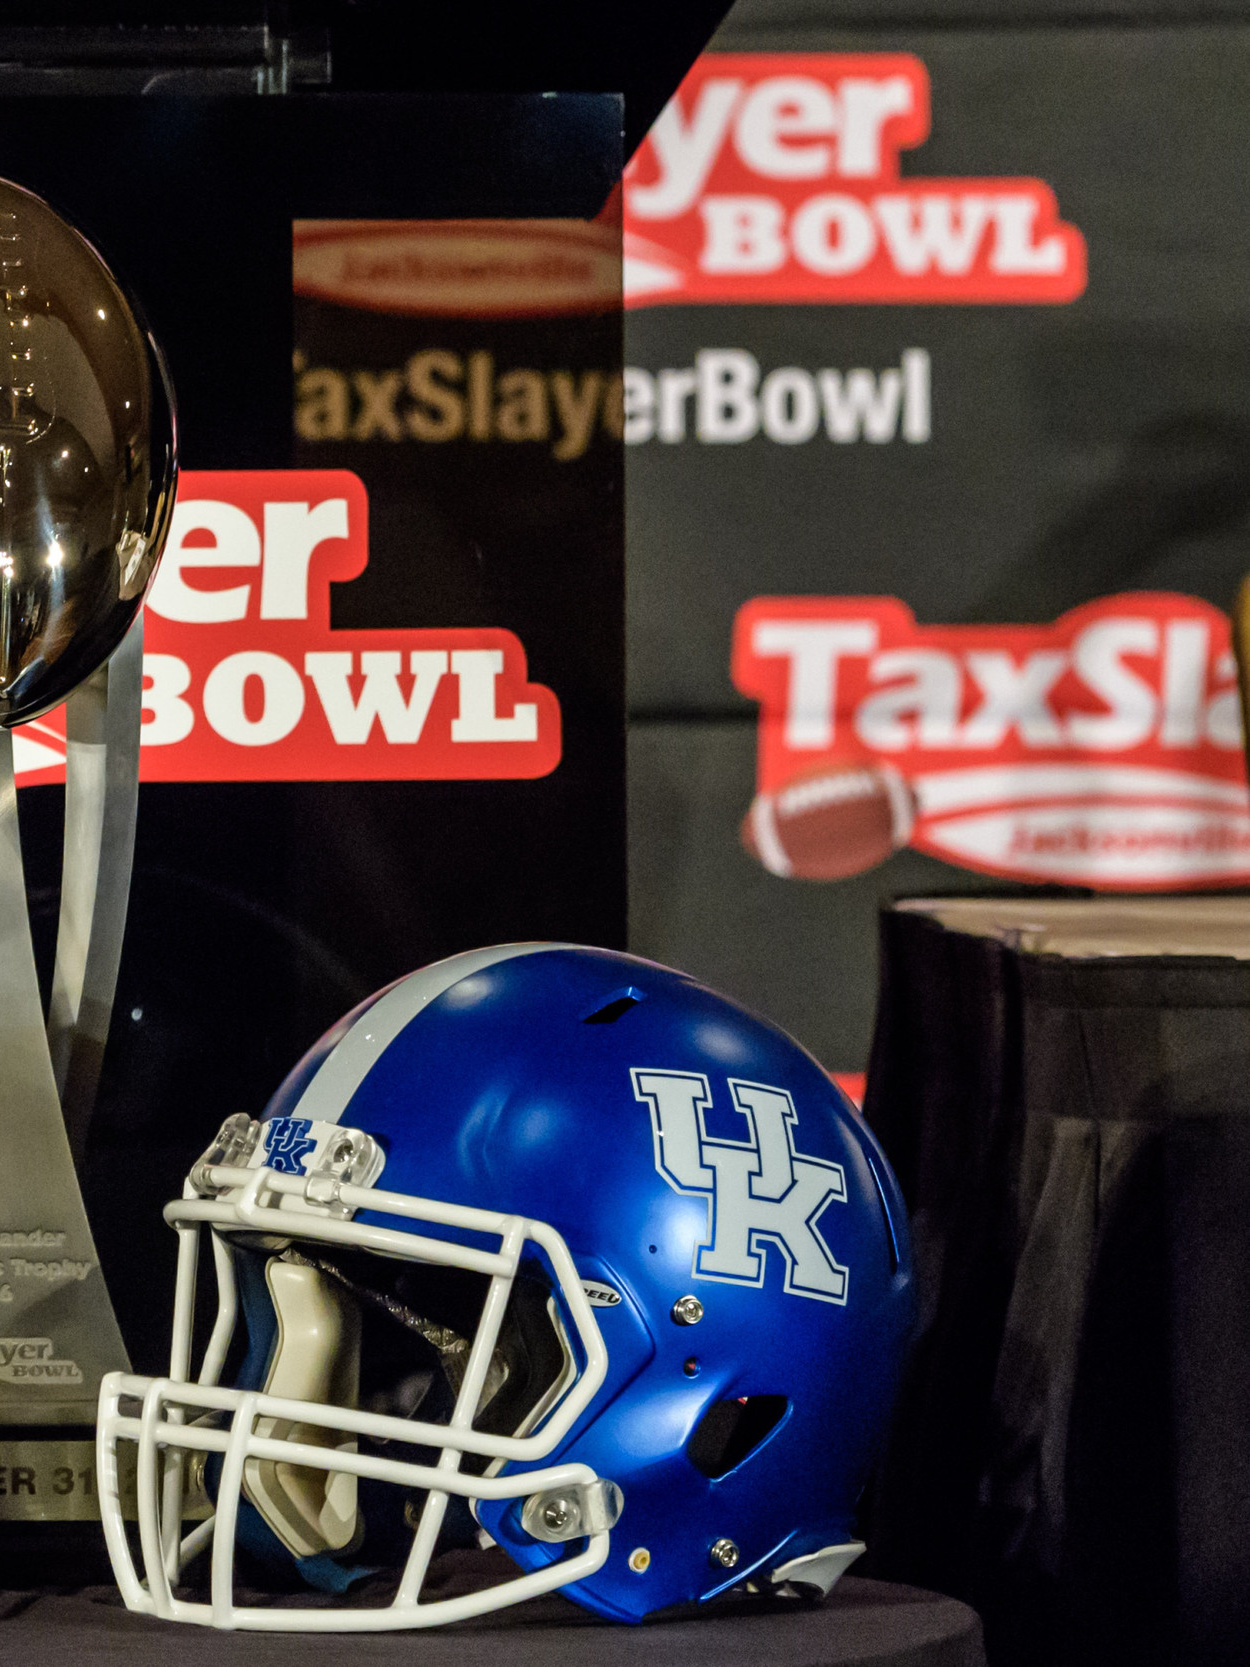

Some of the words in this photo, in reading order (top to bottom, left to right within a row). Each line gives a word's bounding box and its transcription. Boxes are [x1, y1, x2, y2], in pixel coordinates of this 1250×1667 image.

[704, 195, 1066, 276] BOWL
[292, 350, 931, 460] axSlayerBowl
[630, 1067, 848, 1306] UK
[11, 1257, 91, 1280] Trophy
[12, 1365, 80, 1378] BOWL
